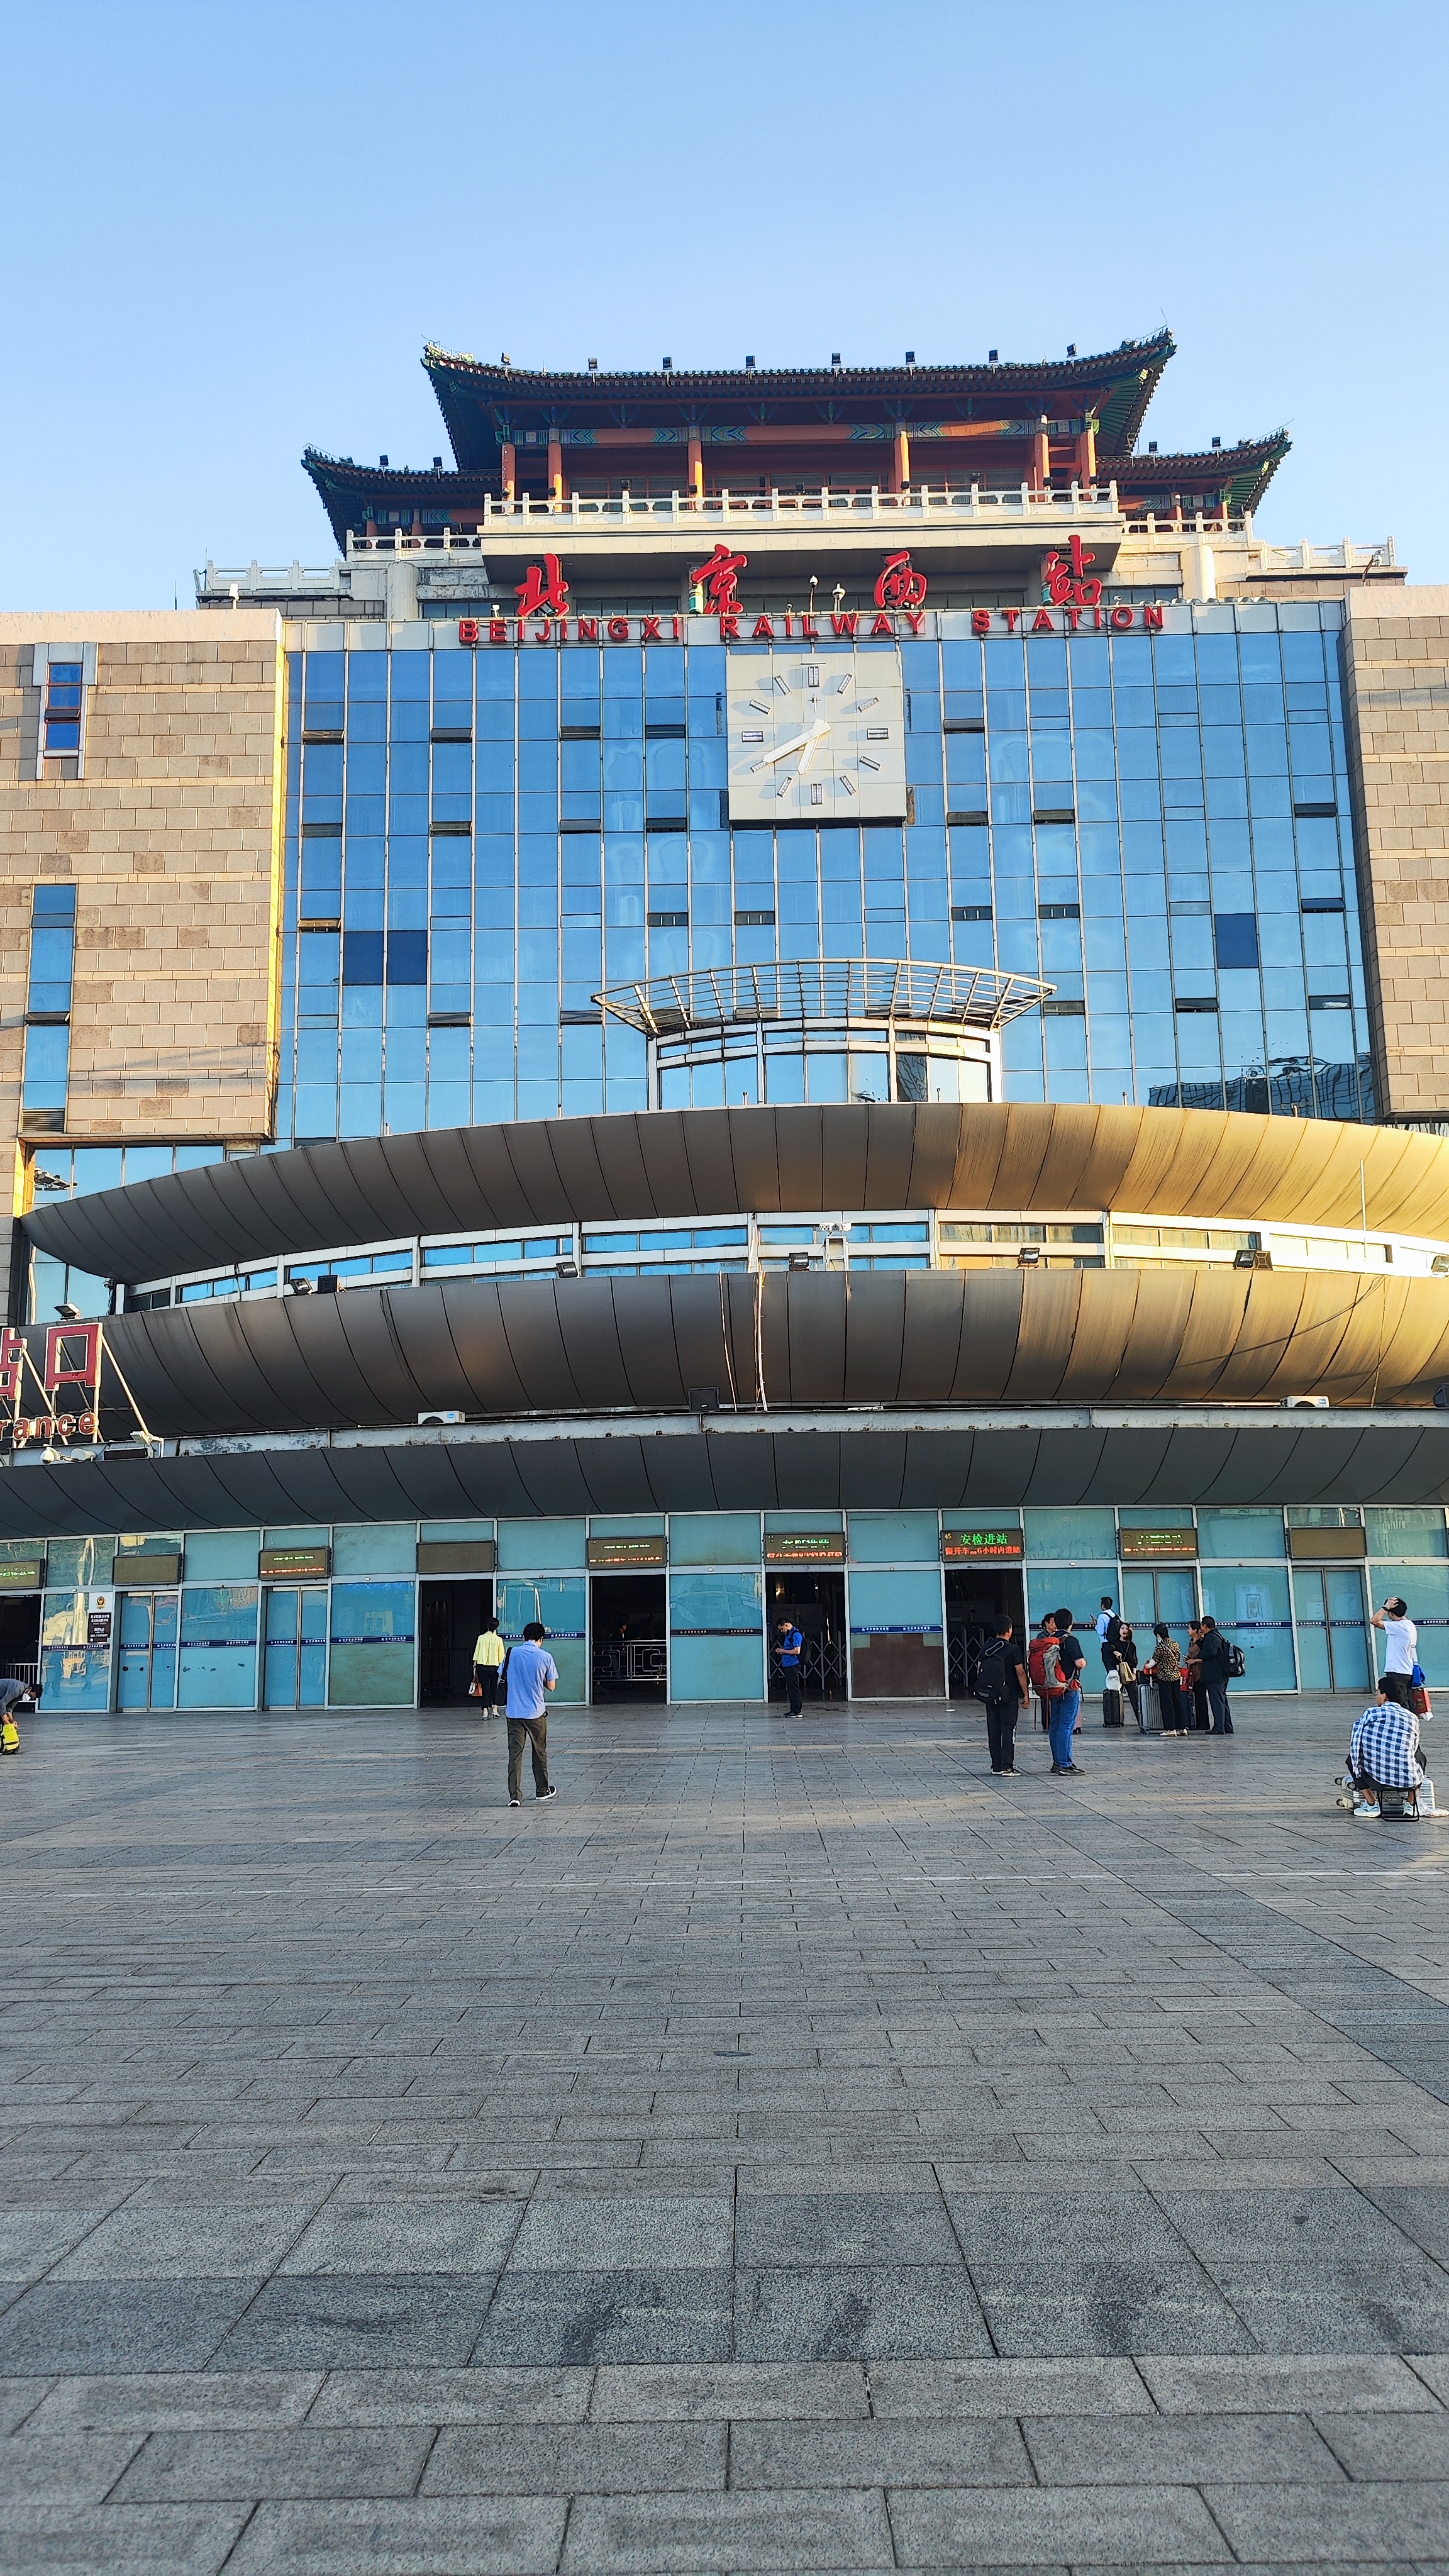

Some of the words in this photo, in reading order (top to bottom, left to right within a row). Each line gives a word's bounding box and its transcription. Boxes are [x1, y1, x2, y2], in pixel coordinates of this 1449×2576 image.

[514, 535, 1103, 617] 北京西站
[460, 616, 681, 643] BEIJINGXI
[720, 611, 924, 638] RAILWAY
[972, 606, 1163, 632] STATION
[960, 1533, 1008, 1546] 安检进站
